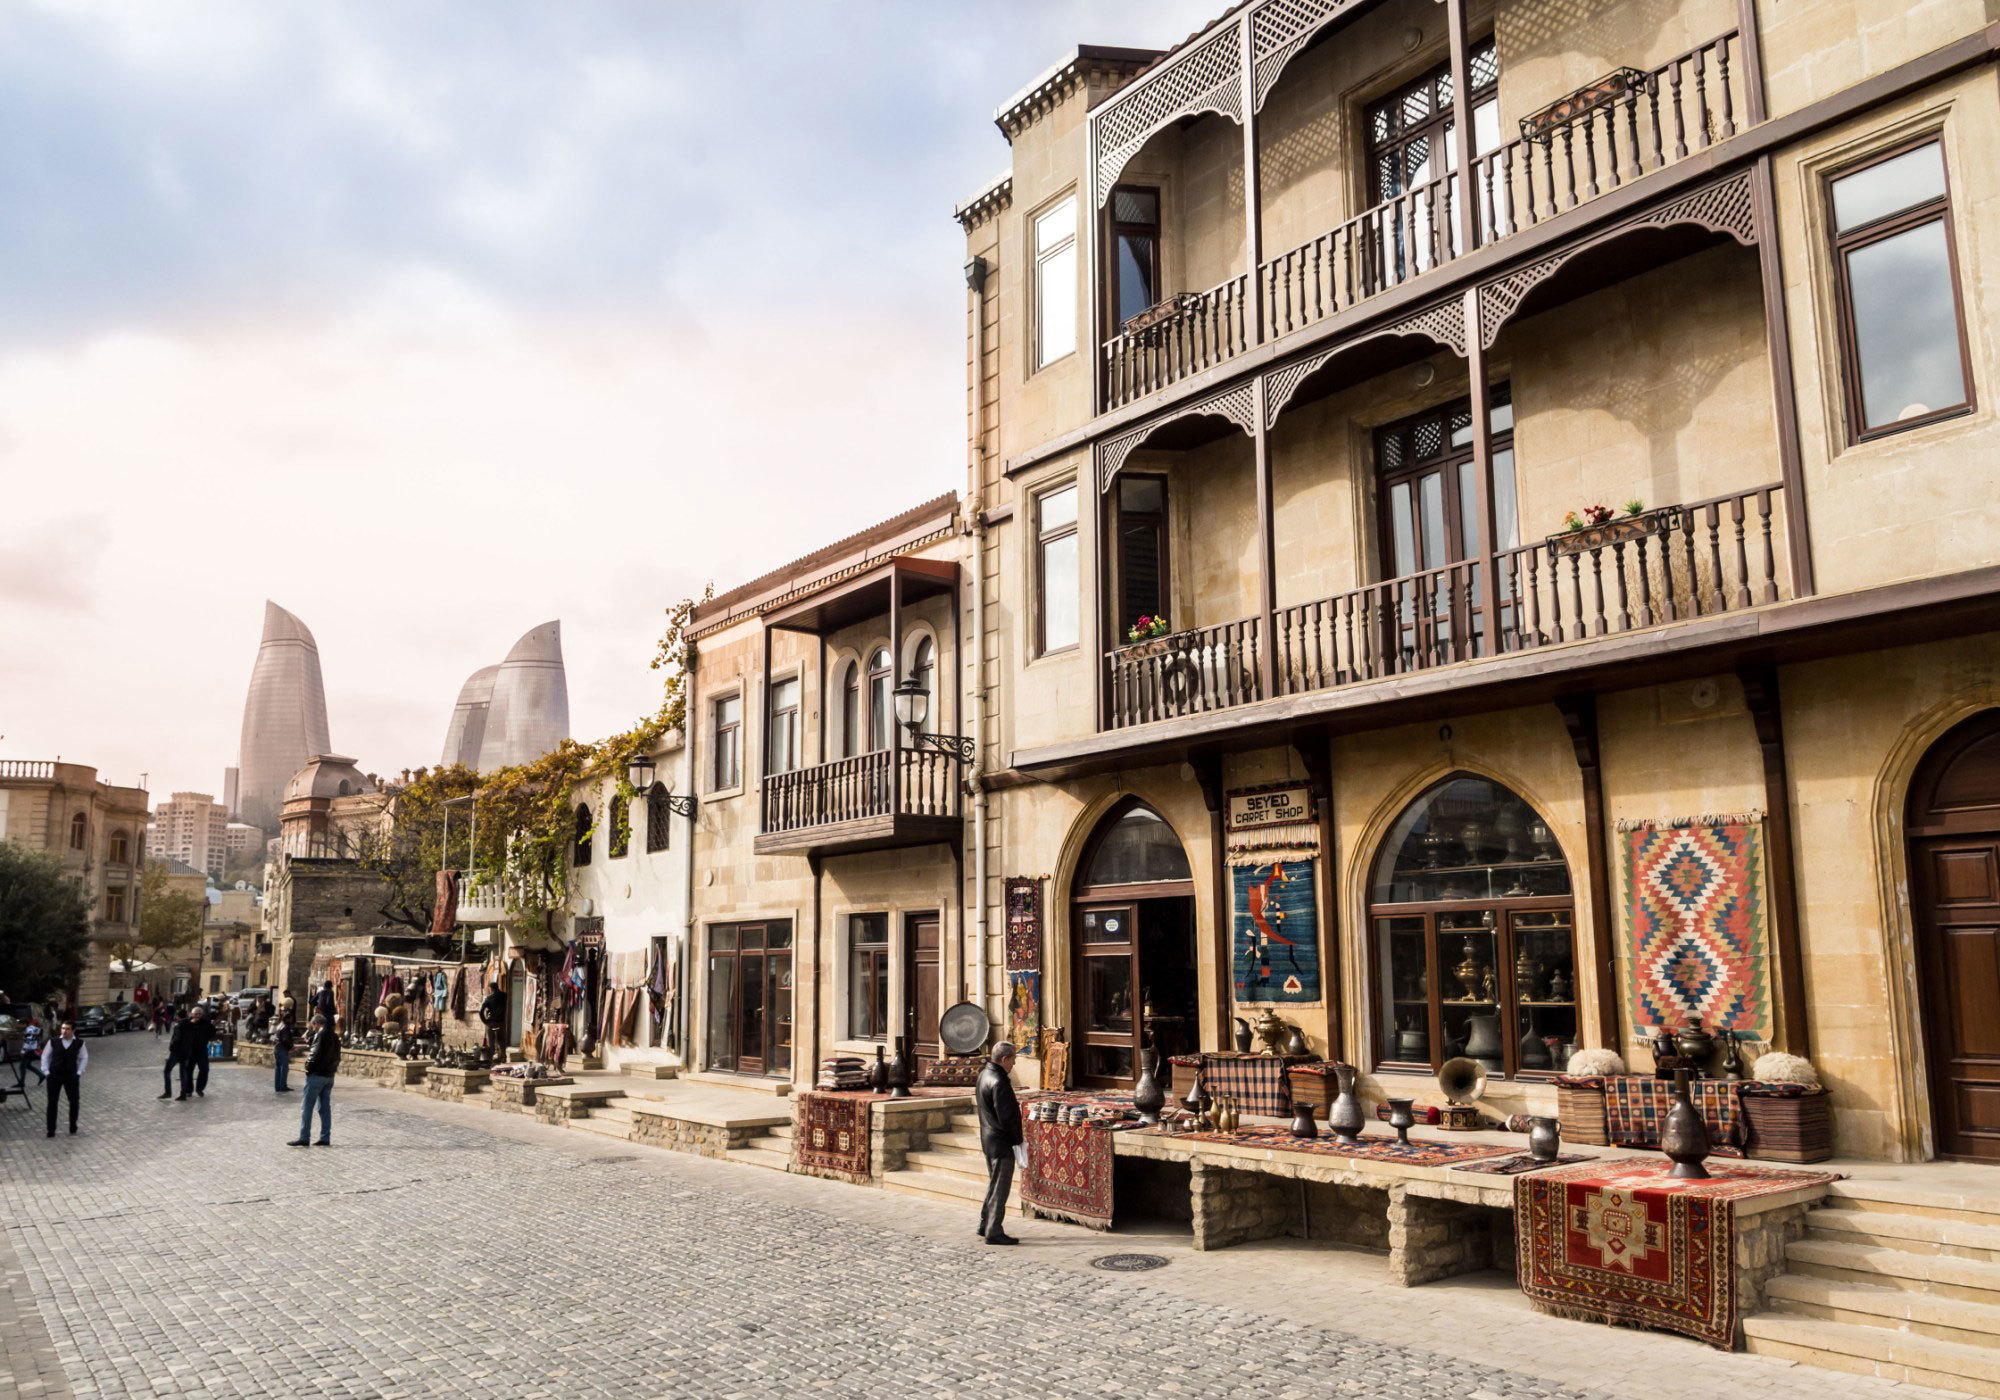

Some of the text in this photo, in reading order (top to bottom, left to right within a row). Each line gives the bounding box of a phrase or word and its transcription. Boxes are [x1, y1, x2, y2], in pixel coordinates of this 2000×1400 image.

[1247, 794, 1290, 811] SEYED
[1235, 806, 1303, 824] CARPET SHOP
